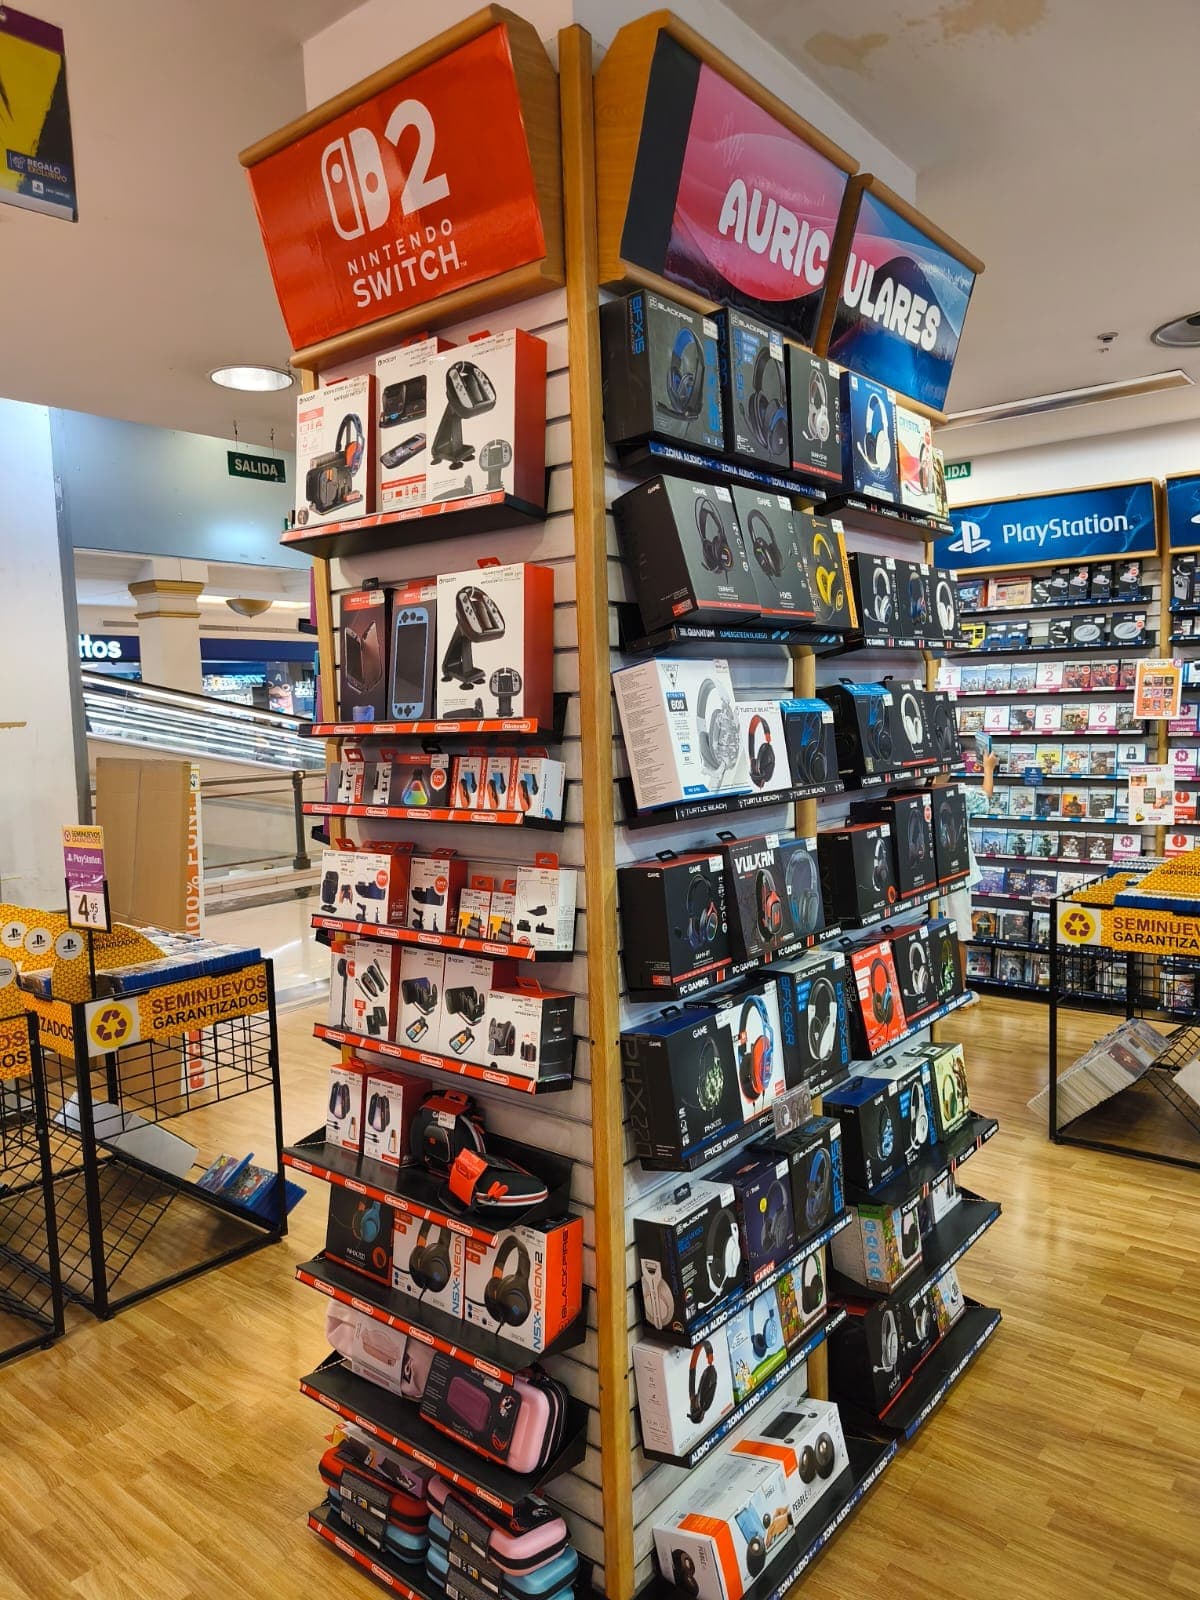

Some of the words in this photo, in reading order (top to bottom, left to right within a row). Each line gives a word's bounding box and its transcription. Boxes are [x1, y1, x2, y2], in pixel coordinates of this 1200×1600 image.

[384, 98, 451, 214] 2
[27, 158, 61, 174] REGALO
[28, 164, 68, 183] EXCLUSIVO
[718, 178, 831, 287] AURIC
[347, 217, 455, 277] NINTENDO
[352, 241, 461, 308] SWITCH
[842, 251, 941, 352] ULARES
[664, 447, 682, 461] ZONA
[234, 458, 278, 476] SALIDA
[1003, 513, 1128, 547] PlayStation
[1046, 671, 1054, 682] 2
[992, 715, 1000, 725] 4
[1044, 714, 1052, 725] 5
[1098, 711, 1107, 723] 6
[503, 722, 529, 730] Nintendo
[743, 797, 762, 807] TURTLE
[762, 794, 779, 804] BEACH
[792, 790, 810, 798] TURTLE
[811, 787, 826, 795] BEACH
[686, 806, 707, 815] TURTLE
[708, 803, 727, 812] BEACH
[73, 854, 102, 865] PlayStation
[689, 865, 701, 874] GAME
[78, 895, 90, 921] 4
[419, 935, 441, 943] Nintendo
[778, 947, 785, 957] PC
[785, 942, 802, 954] GAMING
[732, 965, 739, 974] PC
[740, 959, 759, 972] GAMING
[679, 982, 688, 994] PC
[689, 977, 709, 991] GAMING
[152, 975, 267, 1015] SEMINUEVOS
[153, 991, 267, 1029] GARANTIZADOS
[39, 1017, 73, 1042] ZADOS
[327, 1032, 345, 1041] Nintendo
[693, 1027, 707, 1038] GAME
[381, 1046, 400, 1055] Nintendo
[420, 1056, 443, 1066] Nintendo
[484, 1073, 508, 1083] Nintendo
[294, 1159, 312, 1171] Nintendo
[346, 1180, 366, 1193] Nintendo
[386, 1196, 407, 1208] Nintendo
[448, 1221, 472, 1235] Nintendo
[793, 1252, 805, 1268] ZONA
[805, 1239, 820, 1258] AUDIO
[452, 1236, 463, 1314] NSX-NEON
[561, 1227, 570, 1321] BLACKFIRE
[315, 1281, 334, 1294] Nintendo
[746, 1284, 761, 1302] ZONA
[762, 1272, 777, 1291] AUDIO
[352, 1299, 372, 1313] Nintendo
[532, 1250, 544, 1350] NSX-NEON2
[410, 1327, 433, 1343] Nintendo
[691, 1324, 709, 1347] ZONA
[710, 1311, 728, 1332] AUDIO
[475, 1359, 500, 1376] Nintendo
[776, 1367, 790, 1383] ZONA
[790, 1351, 805, 1370] AUDIO
[320, 1395, 339, 1410] Nintendo
[727, 1410, 743, 1428] ZONA
[743, 1392, 760, 1413] AUDIO
[357, 1416, 376, 1432] Nintendo
[414, 1451, 435, 1468] Nintendo
[691, 1440, 709, 1466] AUDIO
[862, 1474, 875, 1491] ZONA
[875, 1457, 888, 1475] AUDIO
[476, 1488, 501, 1507] Nintendo
[823, 1522, 837, 1540] ZONA
[837, 1504, 850, 1522] AUDIO
[336, 1537, 355, 1556] Nintendo
[372, 1565, 392, 1583] Nintendo
[777, 1575, 793, 1598] ZONA
[794, 1556, 808, 1576] AUDIO
